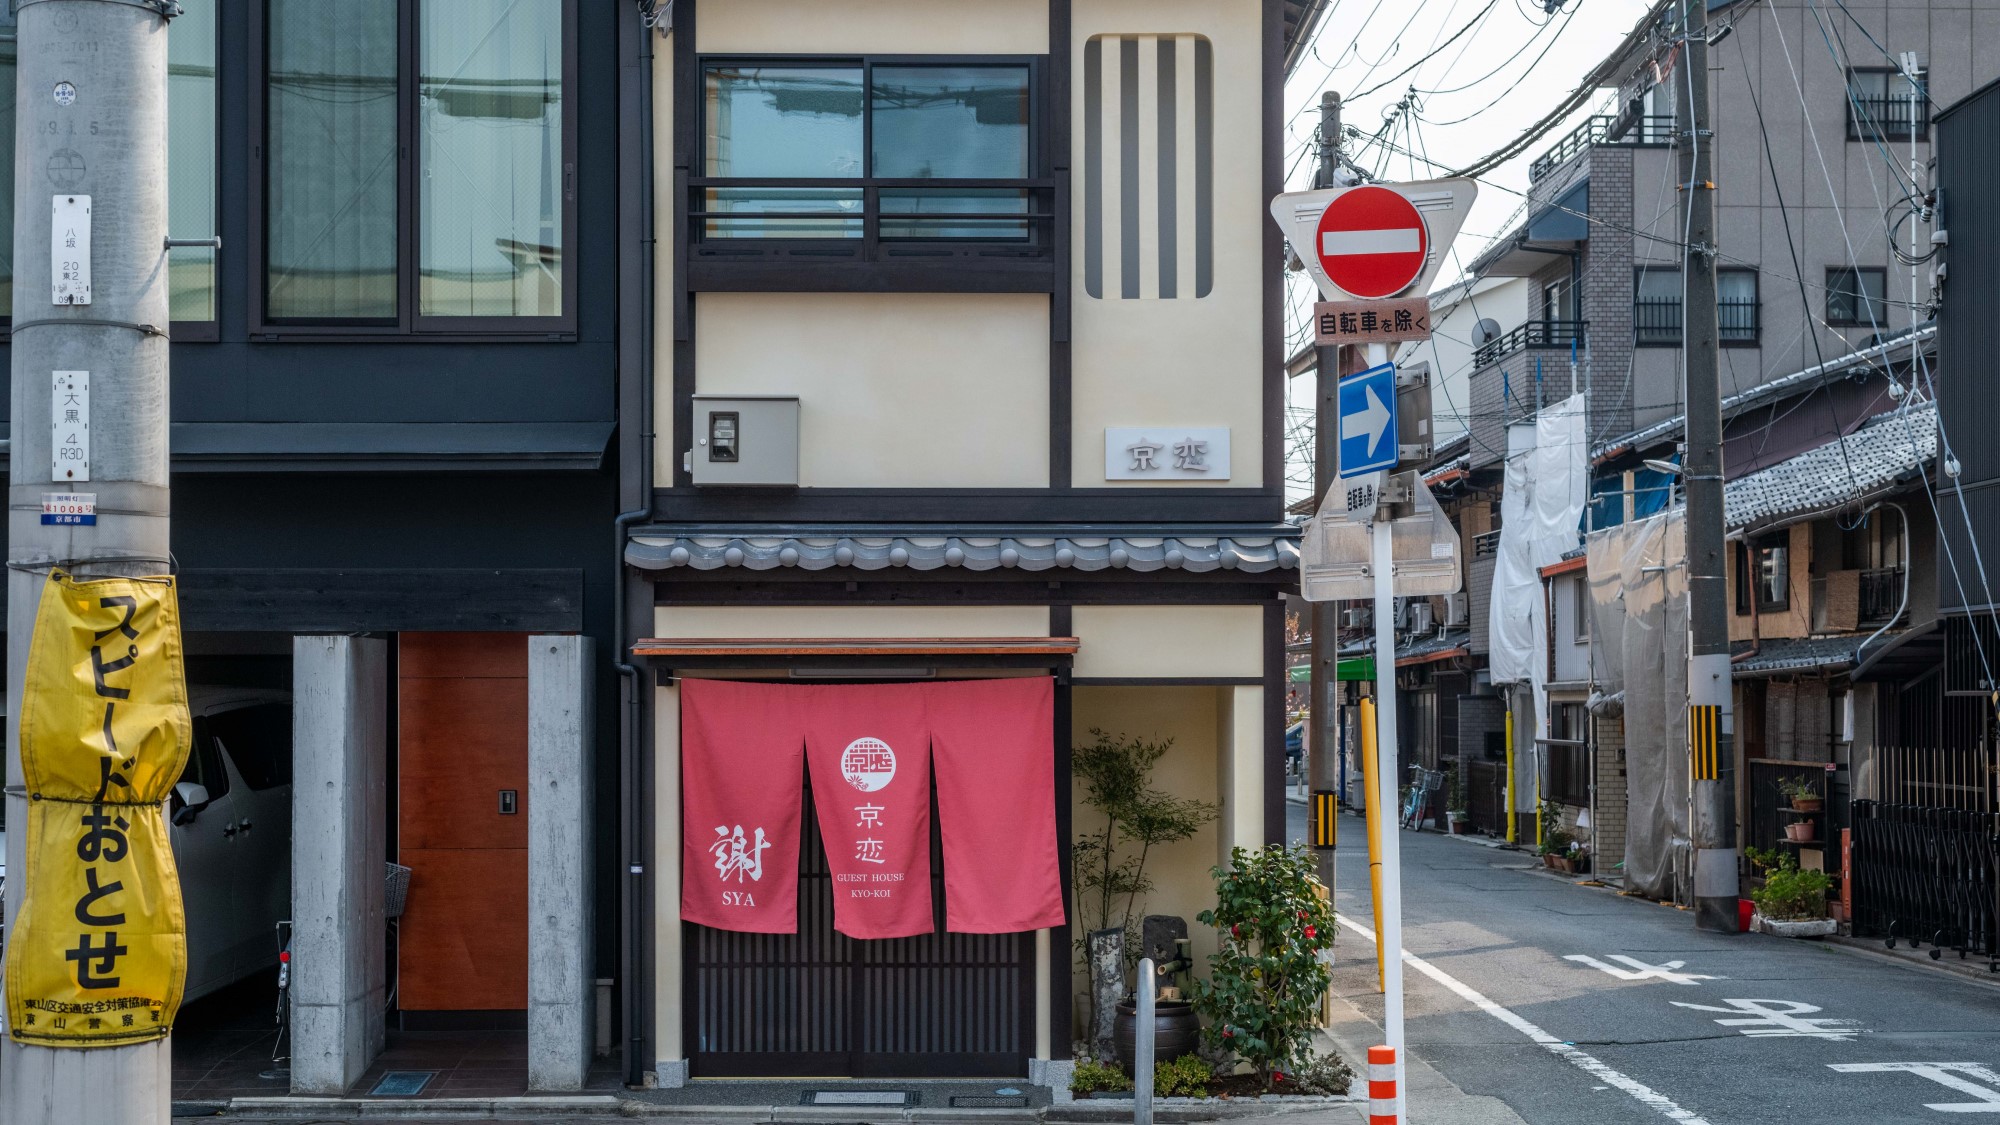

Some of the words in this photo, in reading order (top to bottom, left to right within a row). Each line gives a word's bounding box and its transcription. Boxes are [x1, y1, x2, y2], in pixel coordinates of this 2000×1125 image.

[65, 228, 77, 248] 八坂
[1320, 309, 1426, 335] 自転車を除く
[63, 393, 80, 423] 大黒
[65, 433, 78, 446] 4
[1125, 436, 1210, 472] 京恋
[854, 802, 886, 864] 京恋
[708, 824, 772, 884] 謝
[837, 873, 868, 882] GUEST
[871, 873, 905, 882] HOUSE
[722, 890, 756, 907] SYA
[851, 889, 891, 898] KYO-KOI
